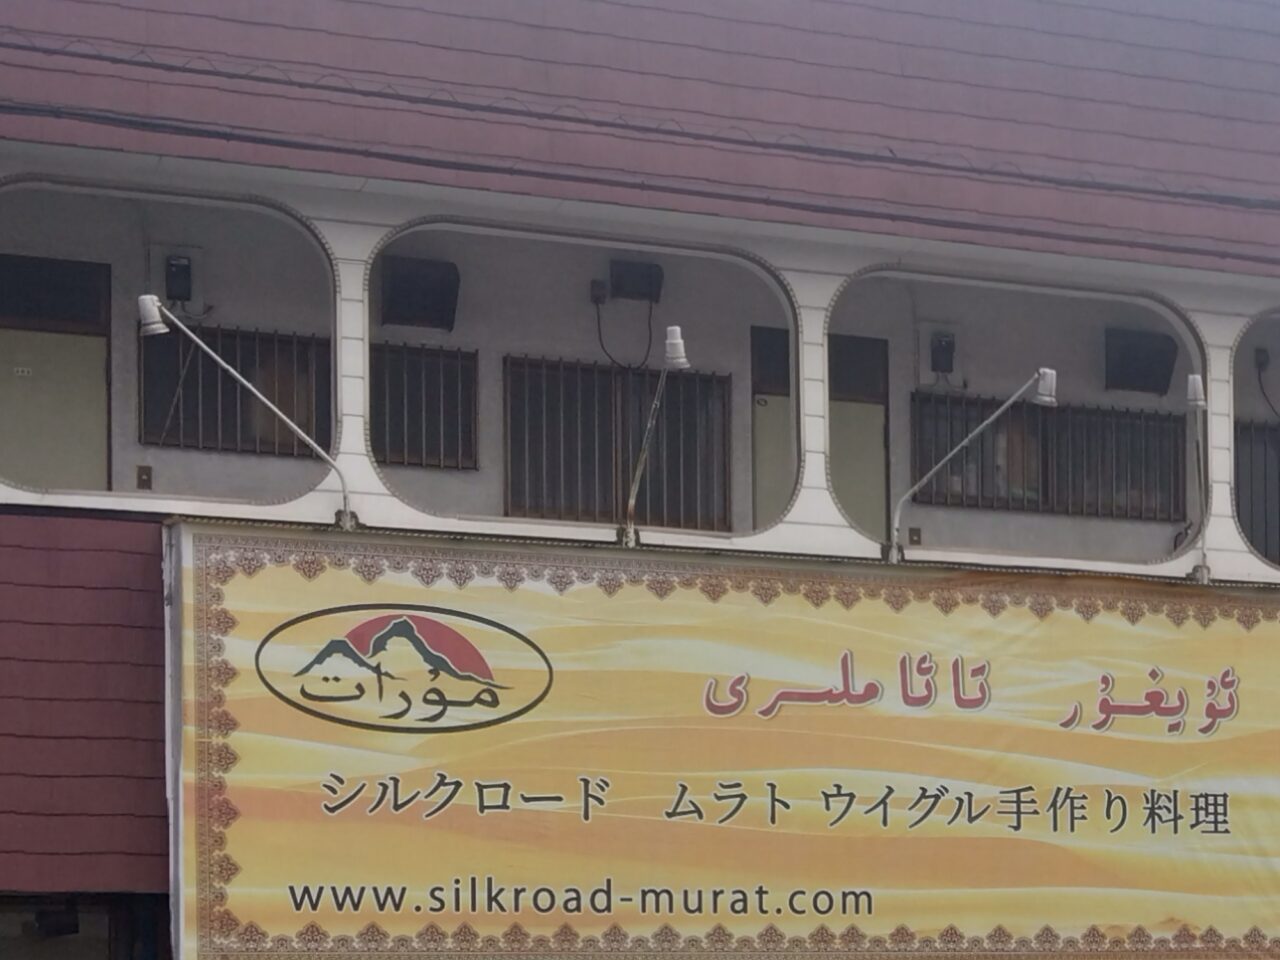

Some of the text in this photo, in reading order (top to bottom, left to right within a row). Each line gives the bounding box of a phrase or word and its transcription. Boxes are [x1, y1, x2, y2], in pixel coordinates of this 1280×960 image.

[321, 772, 1232, 836] シルクロード ムラト ウイグル手作り料理
[288, 877, 874, 915] www.silkroad-murat.com
